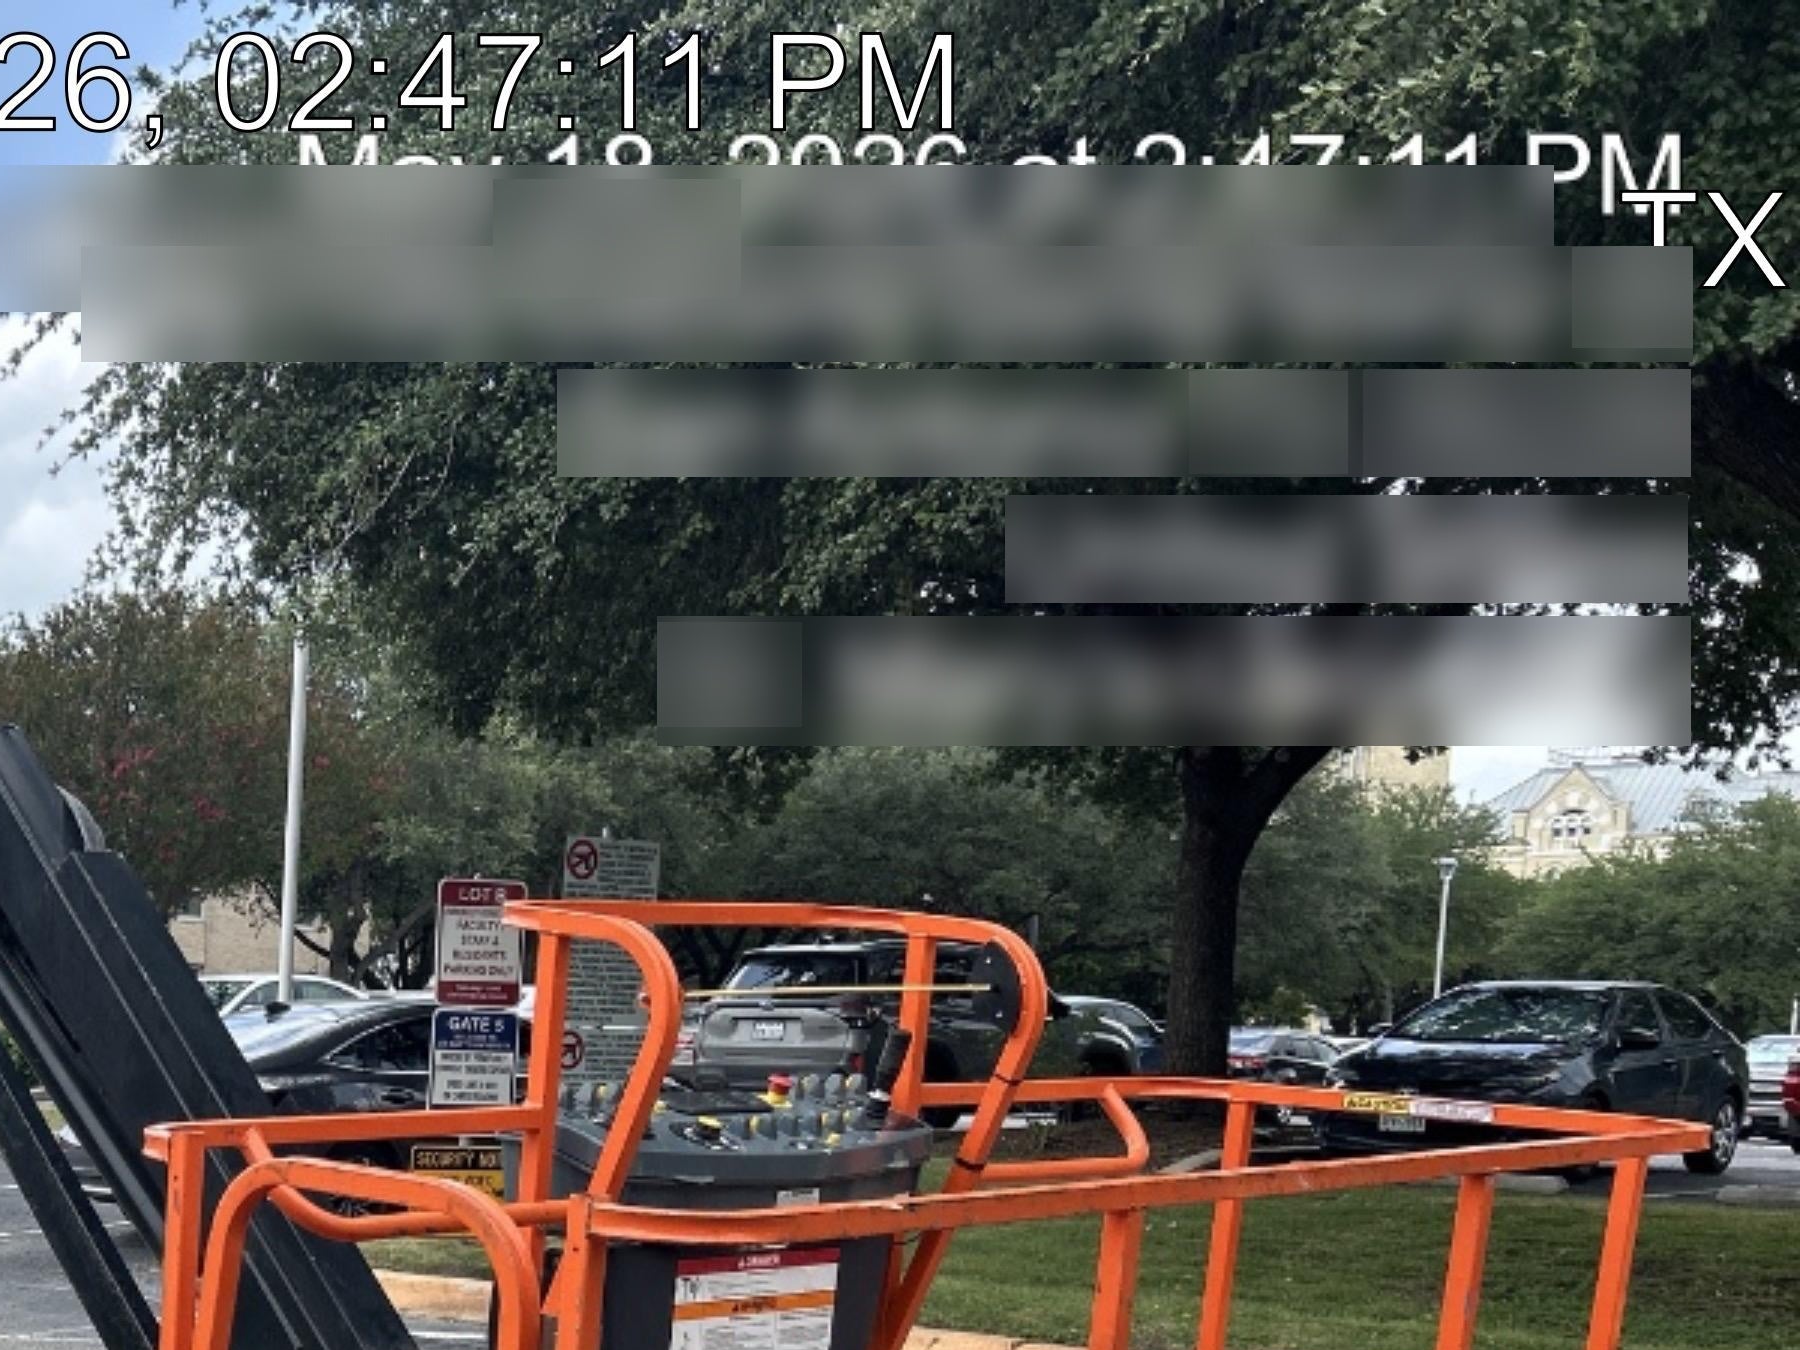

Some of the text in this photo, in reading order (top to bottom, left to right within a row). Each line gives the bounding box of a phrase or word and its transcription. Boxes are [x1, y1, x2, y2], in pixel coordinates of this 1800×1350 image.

[459, 887, 492, 901] LOT
[449, 1016, 491, 1033] GATE
[416, 1151, 475, 1168] SECURITY
